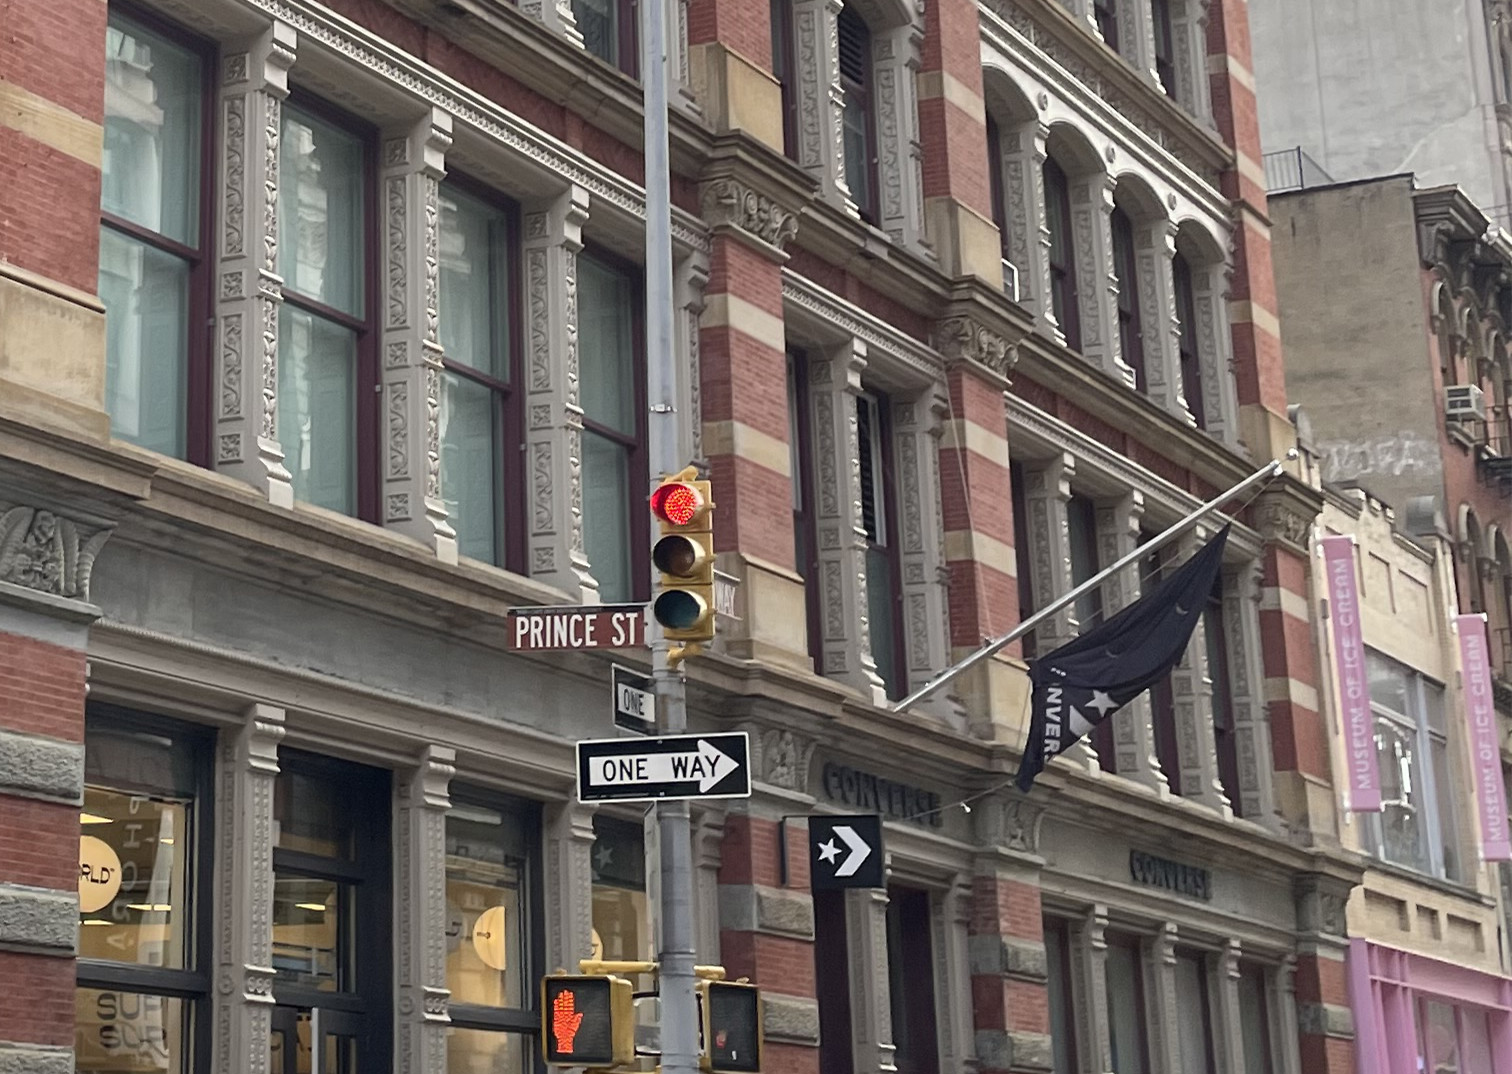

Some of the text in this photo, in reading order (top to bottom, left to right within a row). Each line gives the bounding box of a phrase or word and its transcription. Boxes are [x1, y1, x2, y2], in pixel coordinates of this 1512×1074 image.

[516, 612, 639, 648] PRINCE ST
[1332, 557, 1372, 789] MUSEUM OF ICE CREAM
[623, 688, 645, 716] ONE
[1466, 633, 1503, 842] MUSEUM OF ICE CREAM
[603, 755, 721, 782] ONE WAY
